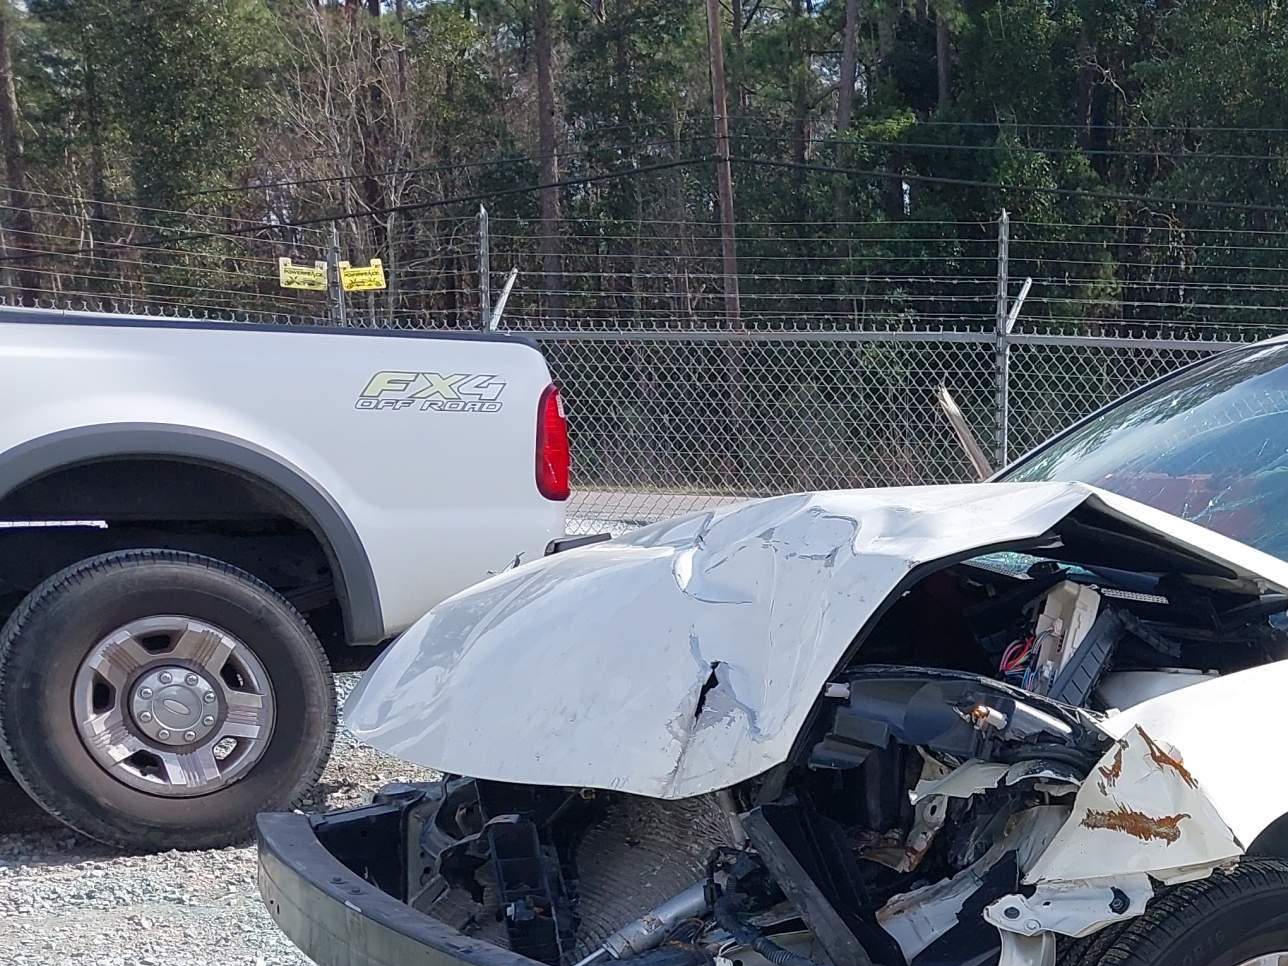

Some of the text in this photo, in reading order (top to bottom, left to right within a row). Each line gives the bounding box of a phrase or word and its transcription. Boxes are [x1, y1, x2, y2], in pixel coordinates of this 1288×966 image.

[360, 370, 507, 401] FX4
[355, 398, 504, 413] OFF ROAD
